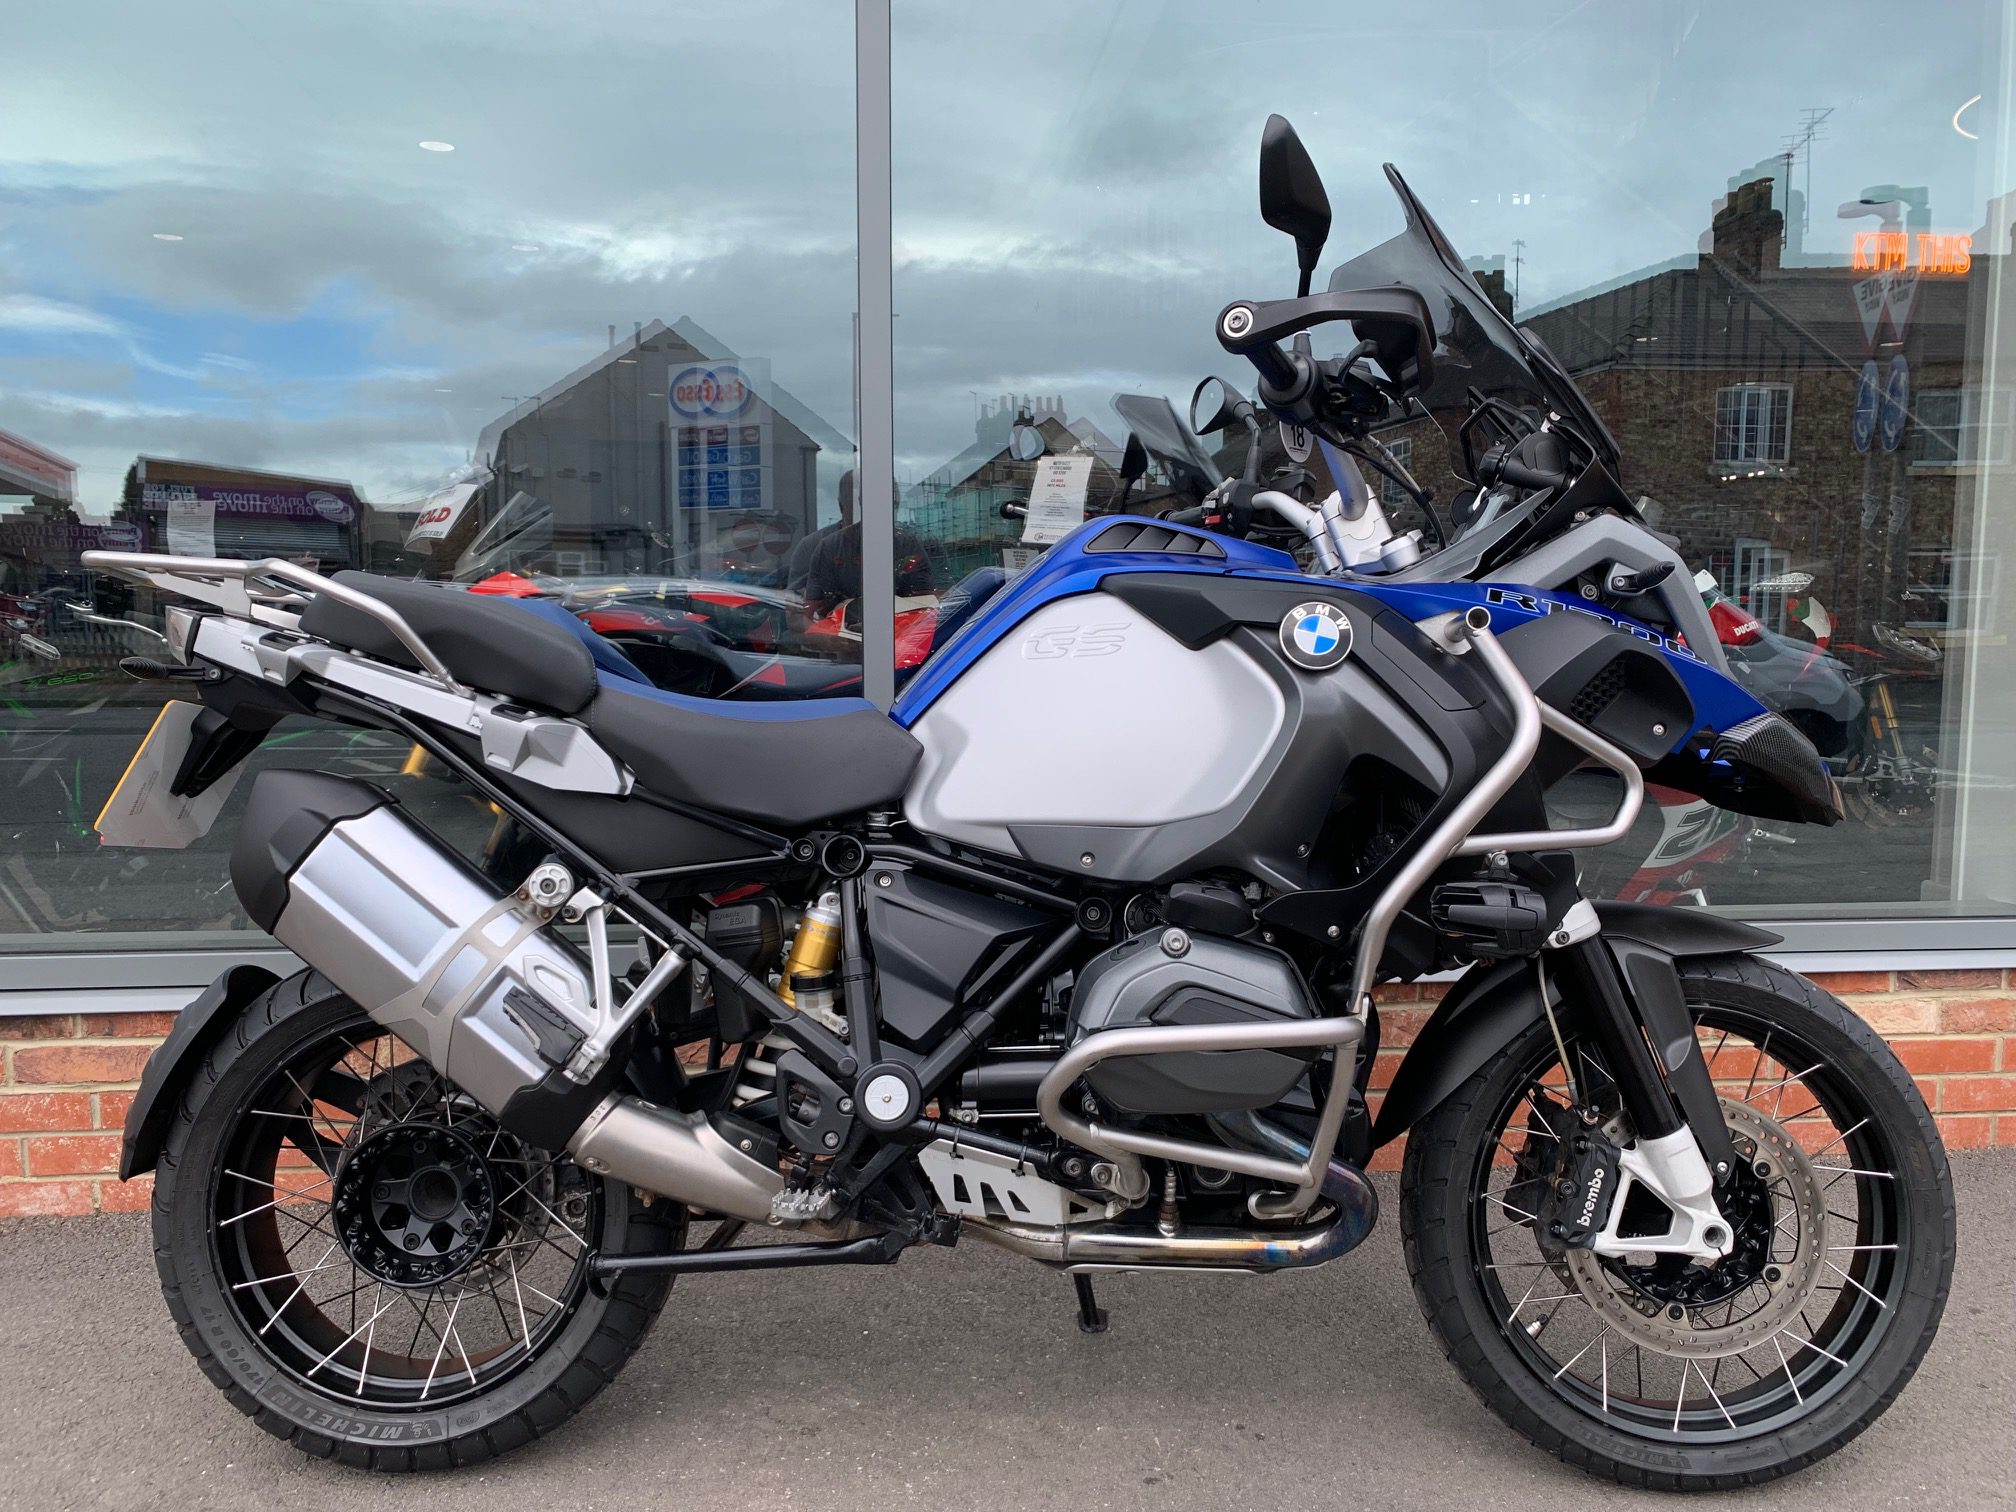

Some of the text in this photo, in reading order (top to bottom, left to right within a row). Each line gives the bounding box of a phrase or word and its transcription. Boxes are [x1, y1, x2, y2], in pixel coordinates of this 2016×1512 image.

[1853, 232, 1973, 273] KTM THIS
[1291, 425, 1305, 448] 18
[1292, 605, 1350, 630] BMW
[1733, 620, 1760, 637] DUCATI
[1021, 622, 1133, 660] GS
[1576, 1168, 1605, 1227] brembo
[270, 1388, 405, 1440] MICHELIN
